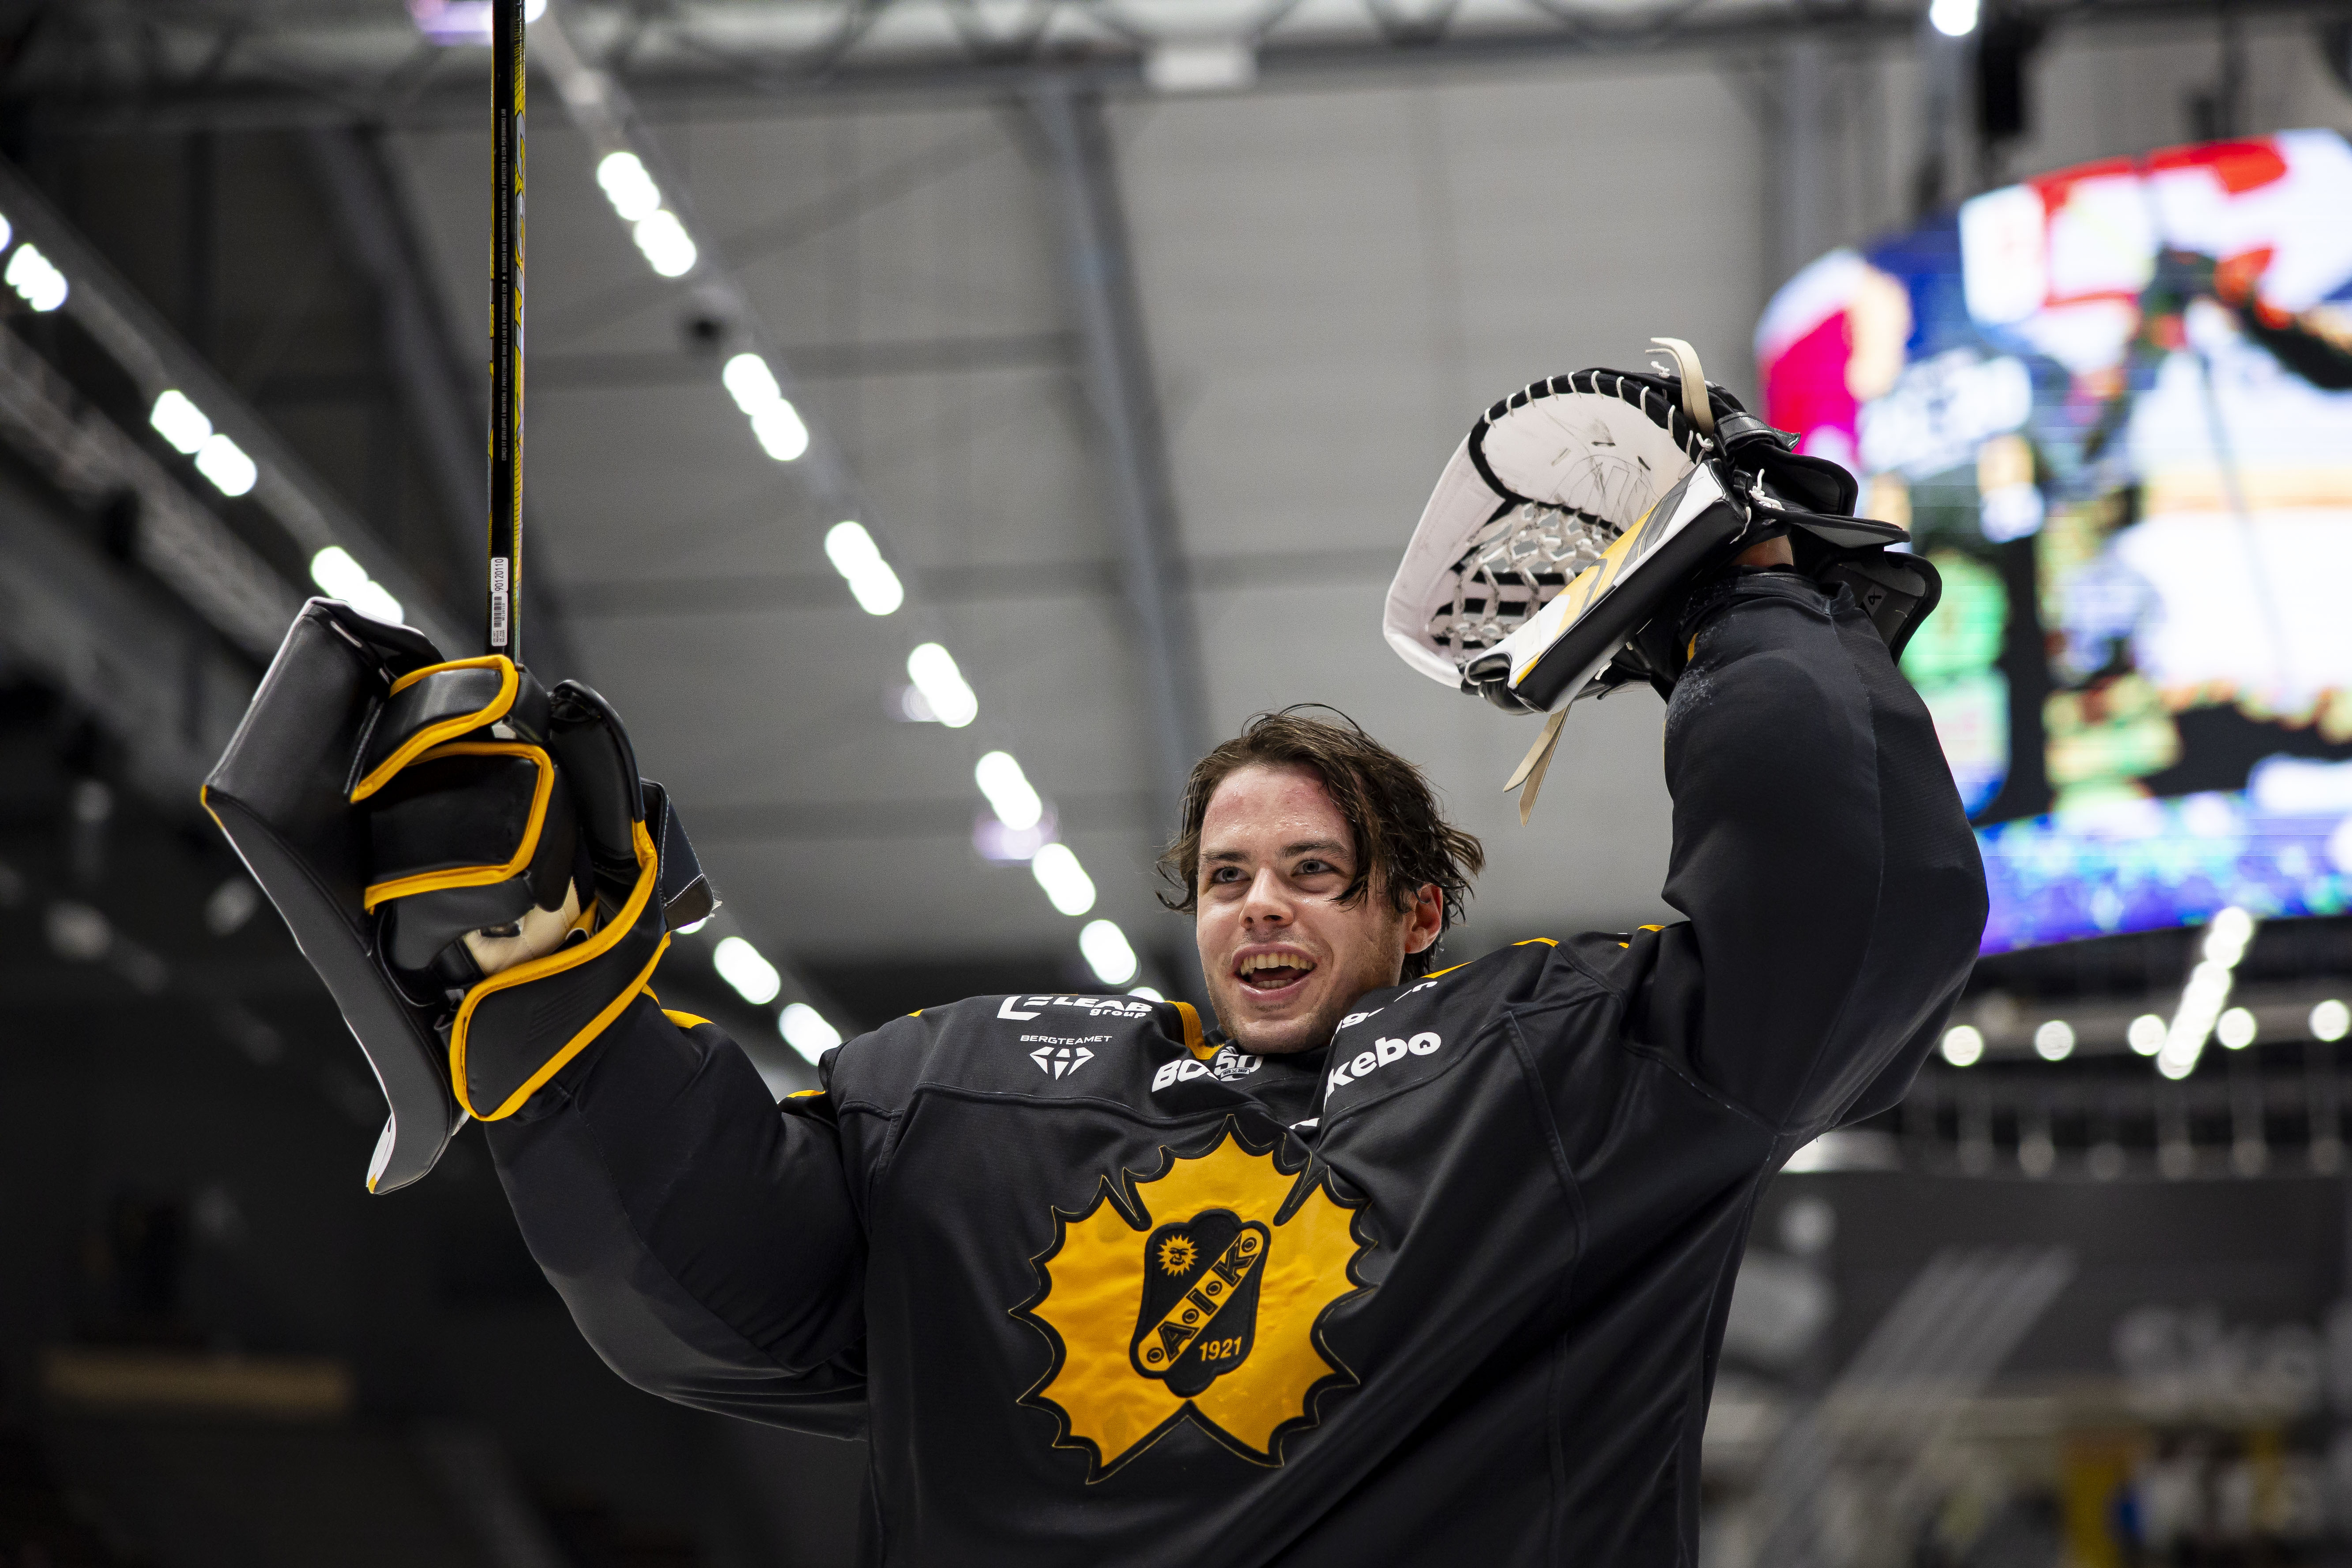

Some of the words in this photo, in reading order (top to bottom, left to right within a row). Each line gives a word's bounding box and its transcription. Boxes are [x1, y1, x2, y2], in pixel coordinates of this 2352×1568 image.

[494, 559, 504, 591] 90120110
[1053, 996, 1153, 1012] LEAB
[1089, 1008, 1147, 1018] group
[1020, 1035, 1112, 1045] BERGTEAMET
[1323, 1032, 1442, 1112] kebo
[1199, 1336, 1242, 1362] 1921
